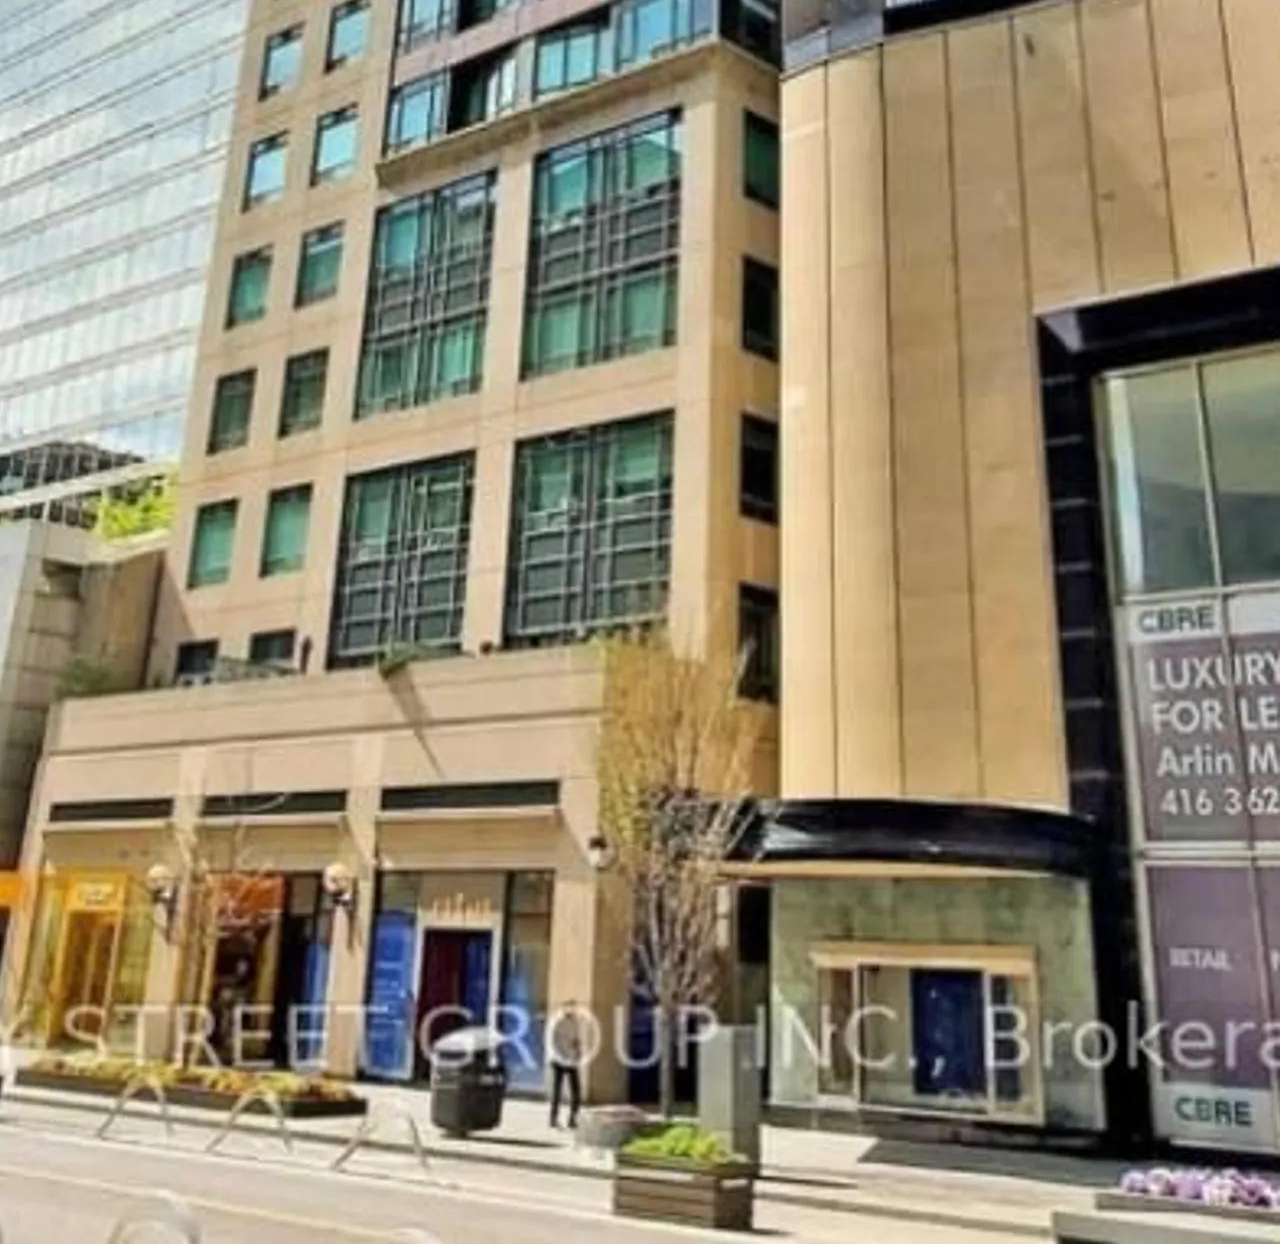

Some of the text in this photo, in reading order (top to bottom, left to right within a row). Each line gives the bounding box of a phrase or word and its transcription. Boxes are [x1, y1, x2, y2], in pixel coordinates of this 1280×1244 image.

[1137, 606, 1215, 634] CBRE
[1152, 701, 1224, 734] FOR
[1157, 744, 1235, 777] Arlin
[1161, 787, 1213, 816] 416
[1175, 1097, 1254, 1127] CBRE
